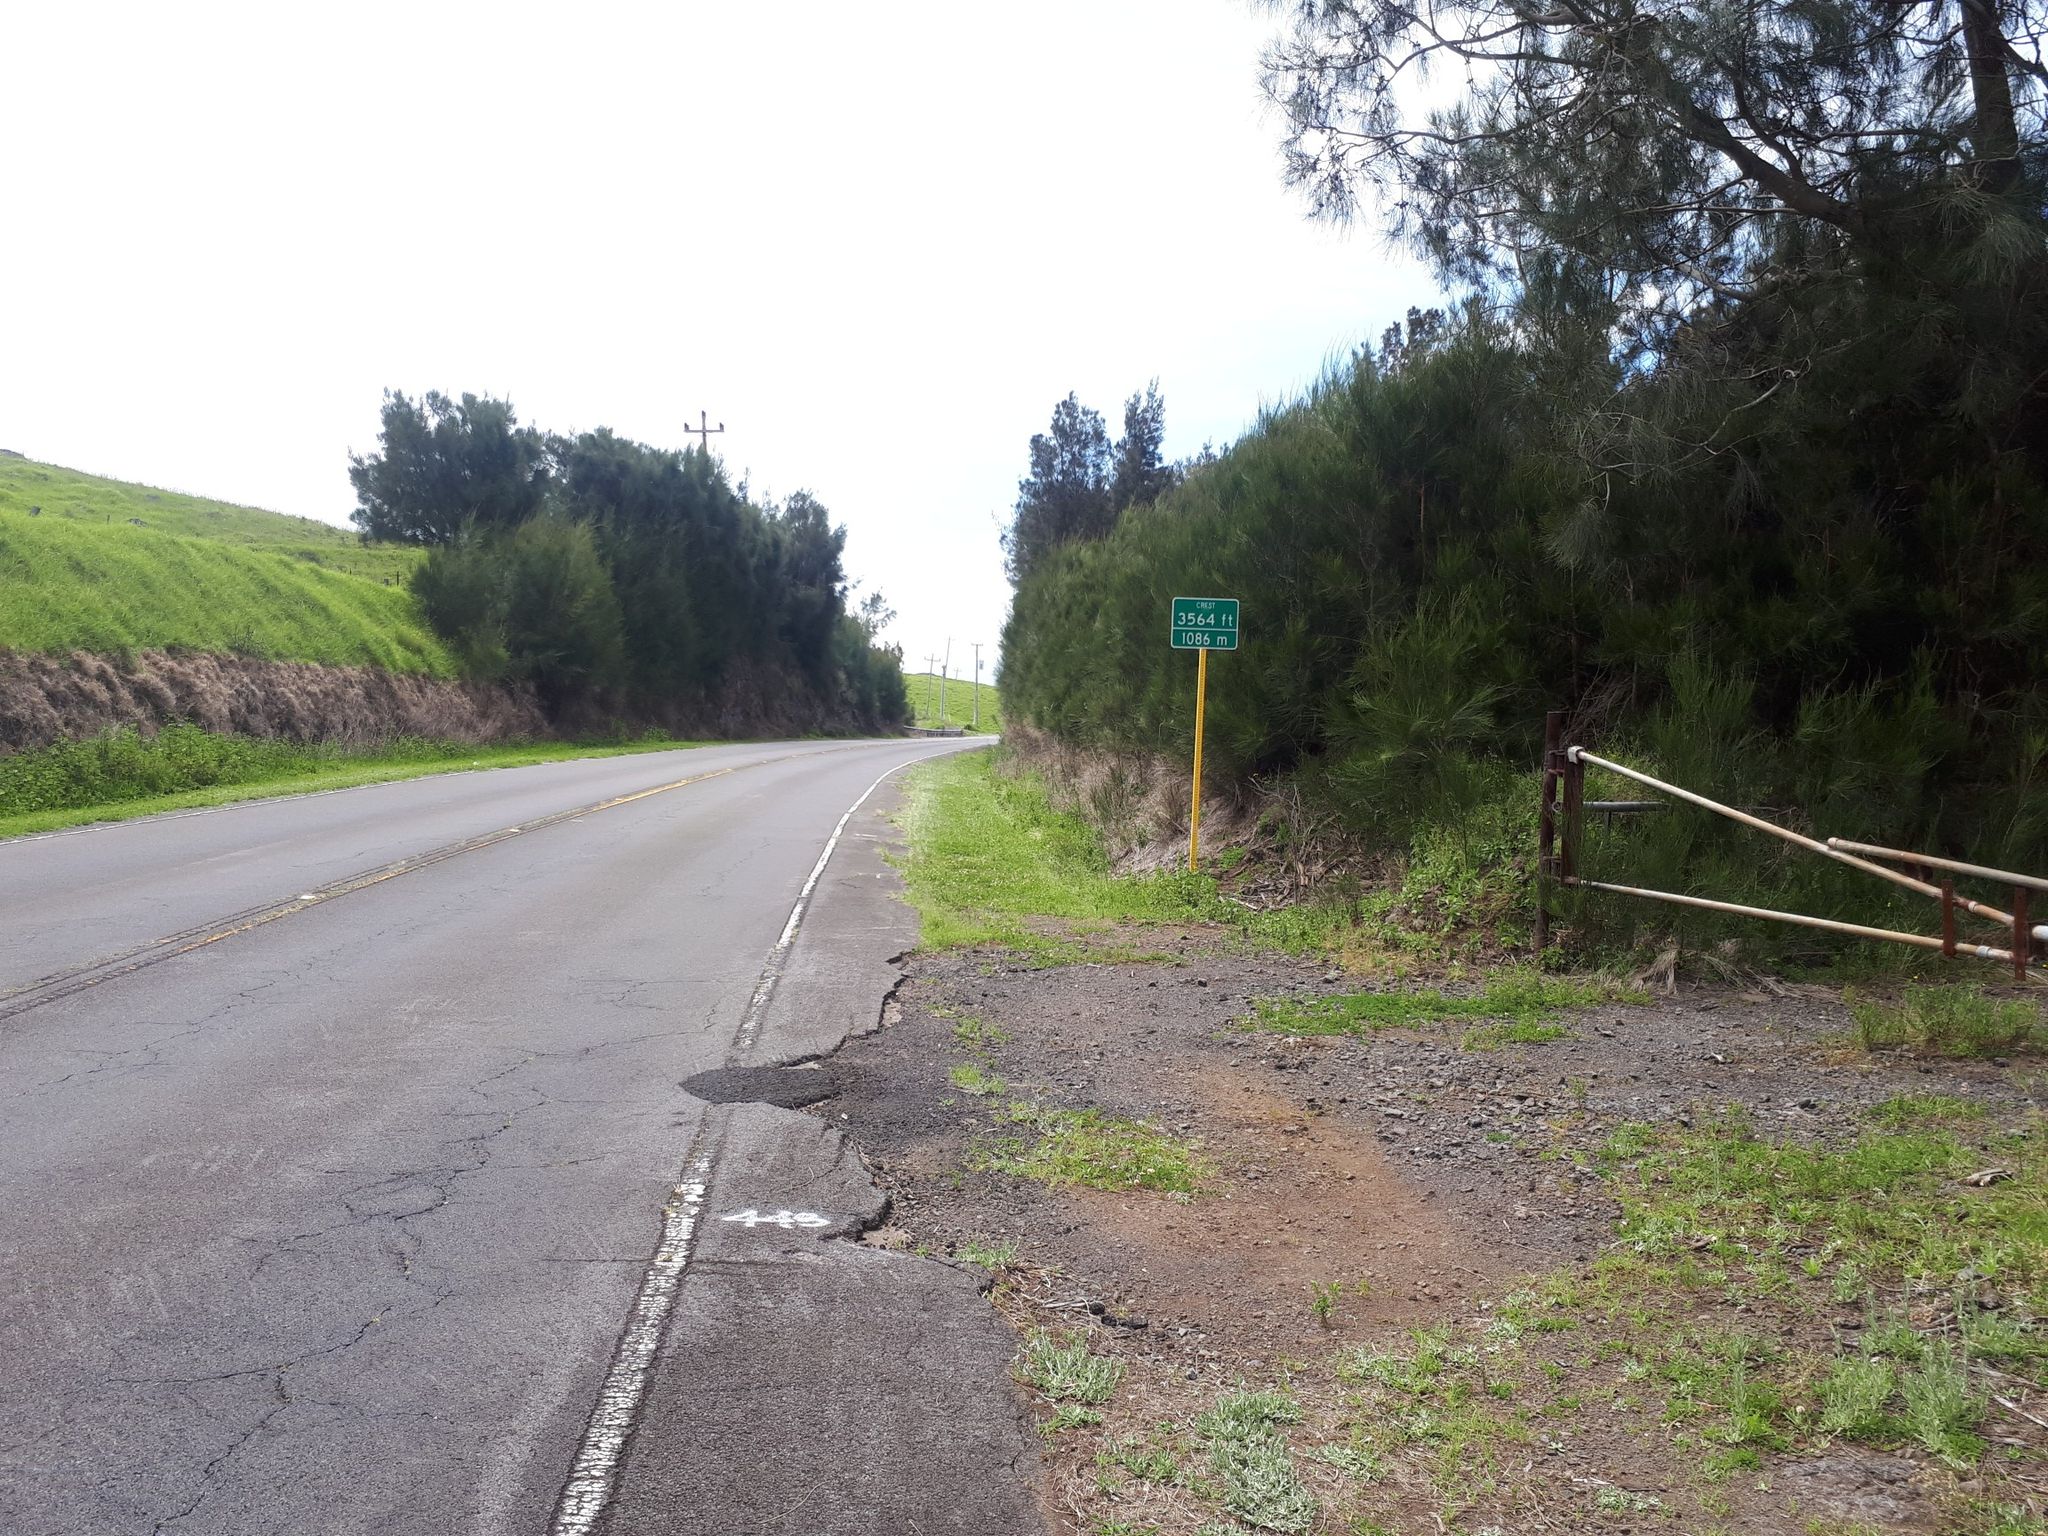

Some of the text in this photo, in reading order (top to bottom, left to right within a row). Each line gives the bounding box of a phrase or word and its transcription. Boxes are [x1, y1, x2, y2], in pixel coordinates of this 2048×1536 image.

[1177, 612, 1233, 626] 3564 ft
[1182, 632, 1228, 646] 1086 m
